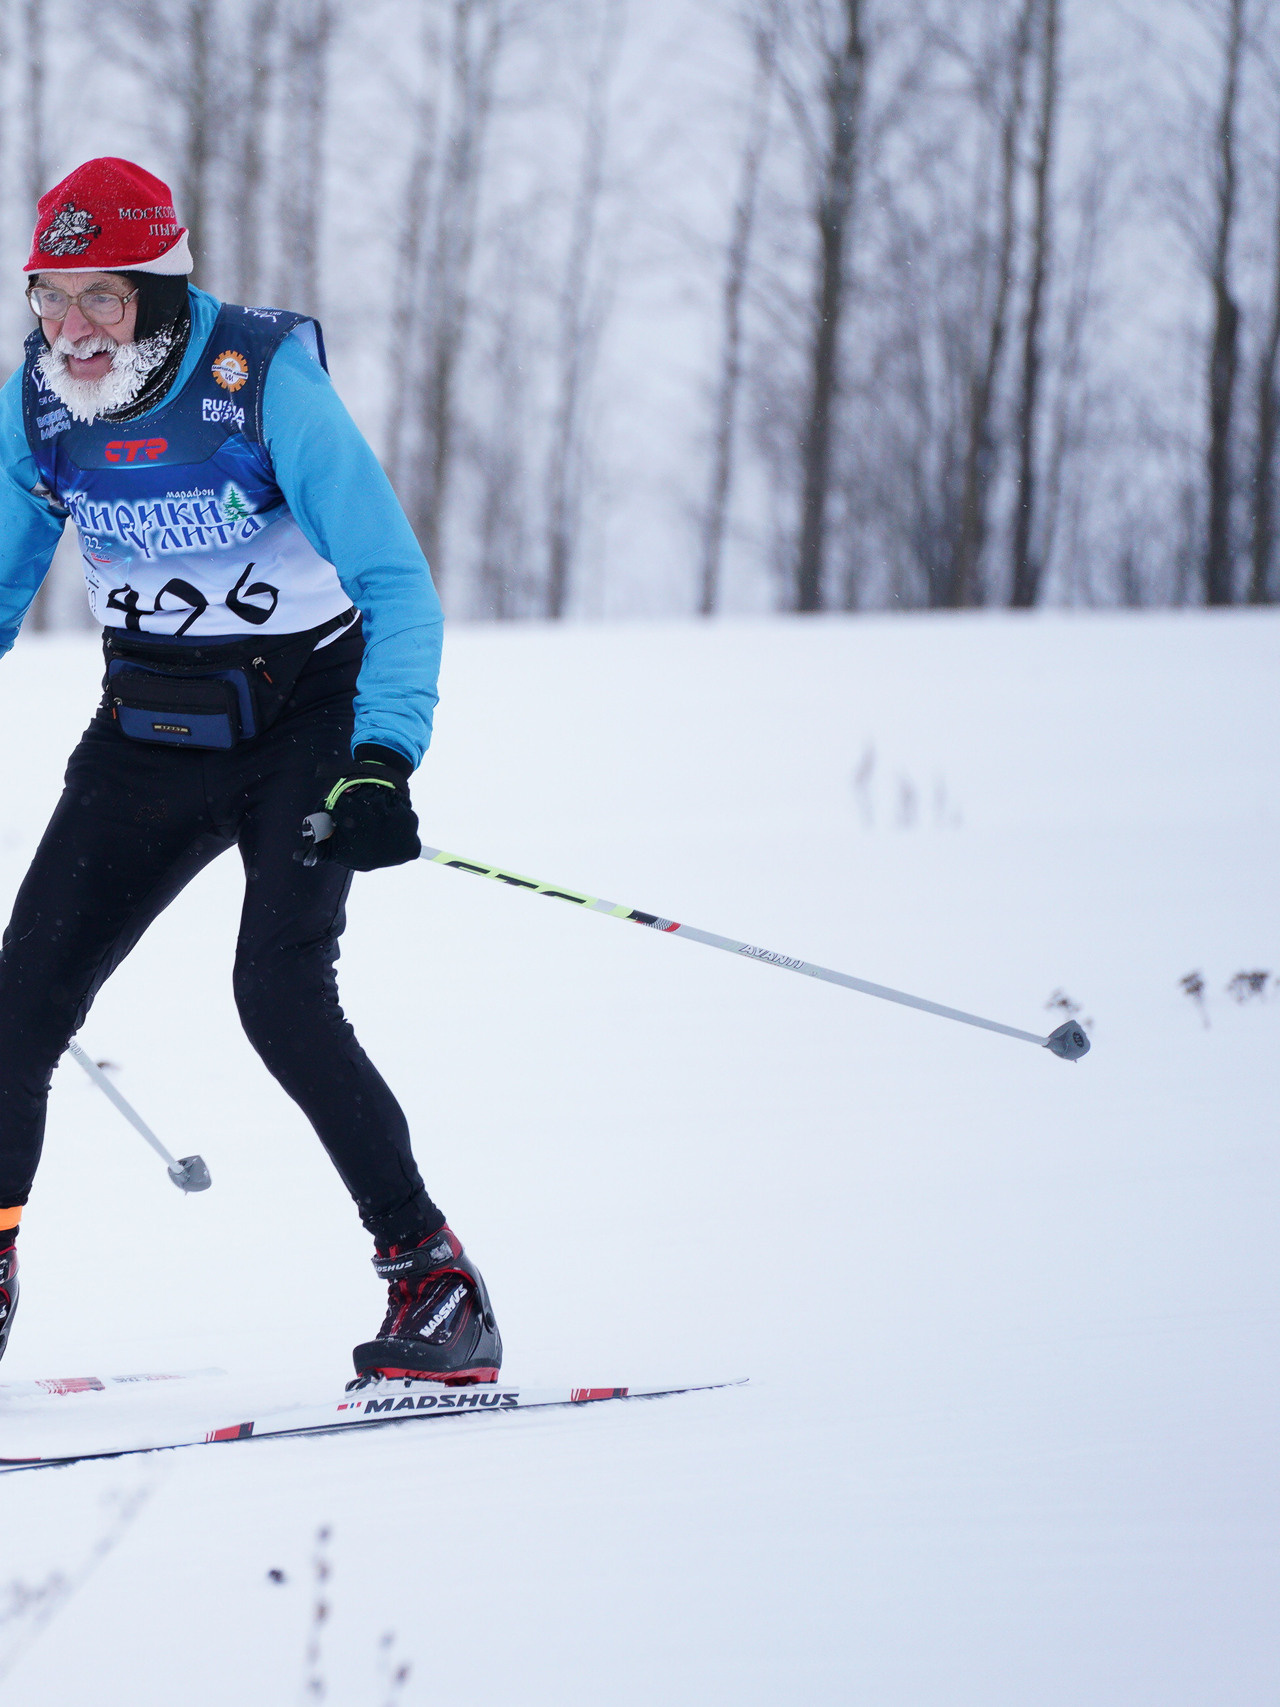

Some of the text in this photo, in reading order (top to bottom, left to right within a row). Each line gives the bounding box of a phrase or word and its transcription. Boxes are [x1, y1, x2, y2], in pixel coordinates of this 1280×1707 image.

[166, 487, 215, 500] марафон
[106, 562, 281, 636] 496
[419, 1283, 468, 1338] MADSHUS
[363, 1393, 520, 1414] MADSHUS
